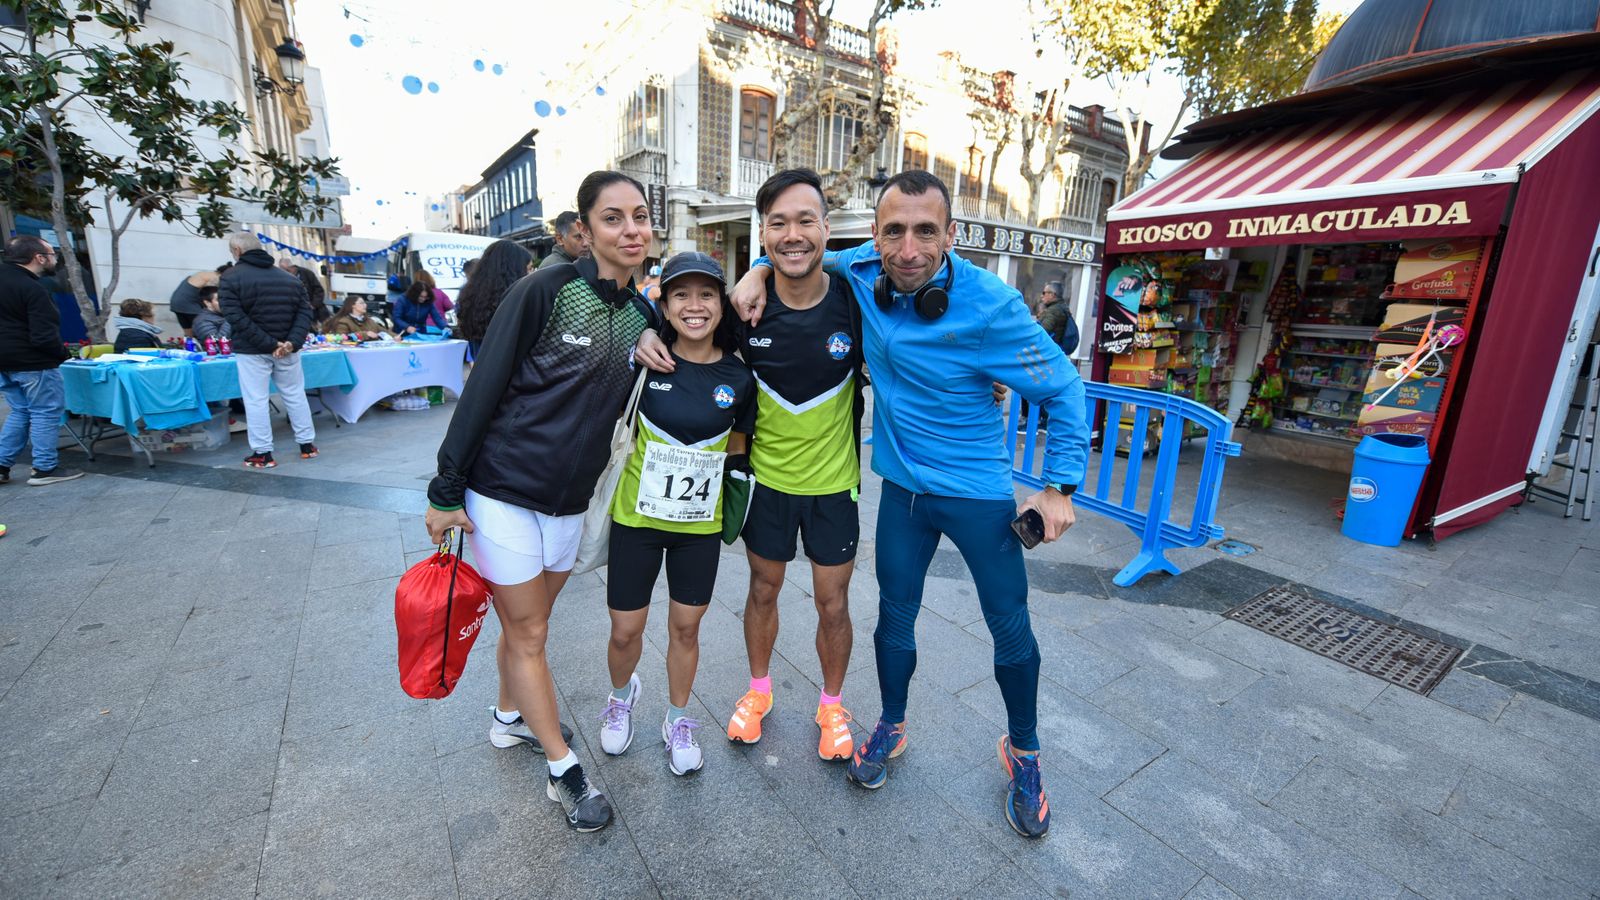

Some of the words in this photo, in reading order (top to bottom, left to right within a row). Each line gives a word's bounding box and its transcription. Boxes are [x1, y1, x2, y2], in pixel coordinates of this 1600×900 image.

[1117, 221, 1213, 246] KIOSCO
[1226, 201, 1471, 238] INMACULADA
[954, 222, 986, 248] AR
[992, 227, 1025, 253] DE
[1030, 234, 1096, 262] TAPAS
[1411, 279, 1454, 290] Grefusa
[1103, 322, 1134, 333] Doritos
[661, 474, 711, 501] 124
